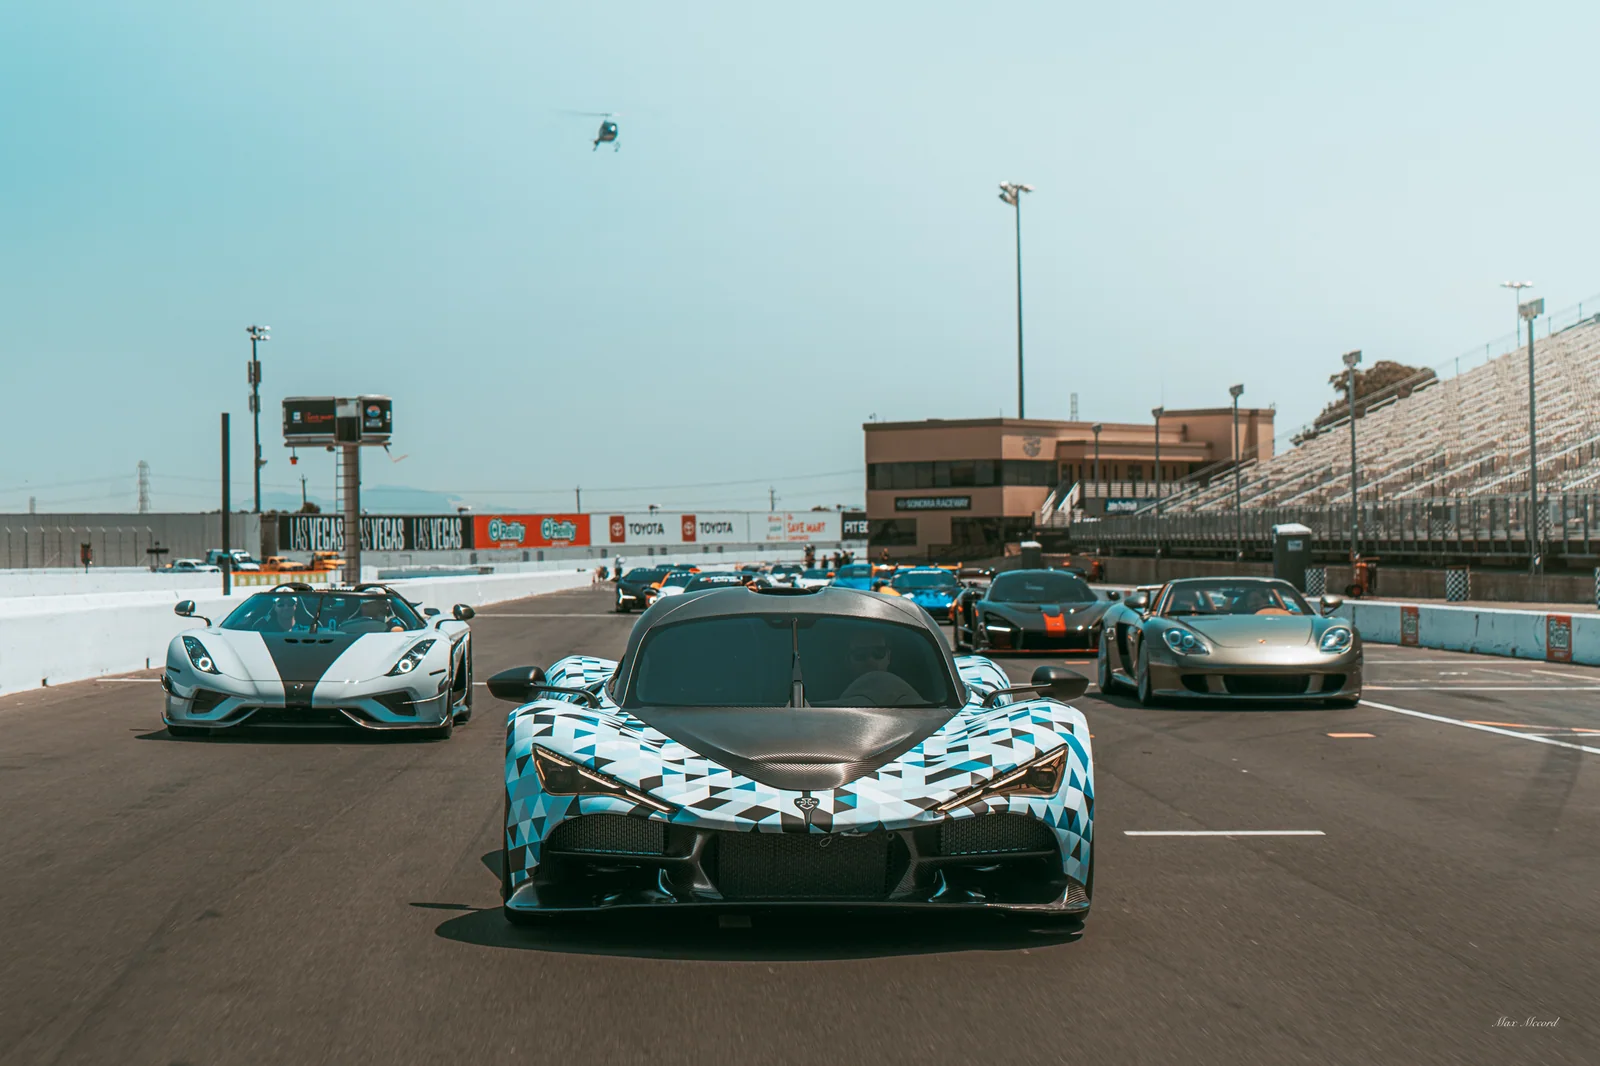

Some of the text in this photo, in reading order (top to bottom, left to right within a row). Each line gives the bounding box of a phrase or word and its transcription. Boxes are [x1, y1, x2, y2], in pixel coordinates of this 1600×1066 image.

[907, 498, 968, 508] SONOMA RACEWAY
[290, 517, 344, 551] LAS VEGAS
[359, 518, 404, 551] AS VEGAS
[413, 518, 462, 551] LAS VEGAS
[629, 523, 664, 534] TOYOTA
[699, 522, 733, 533] TOYOTA
